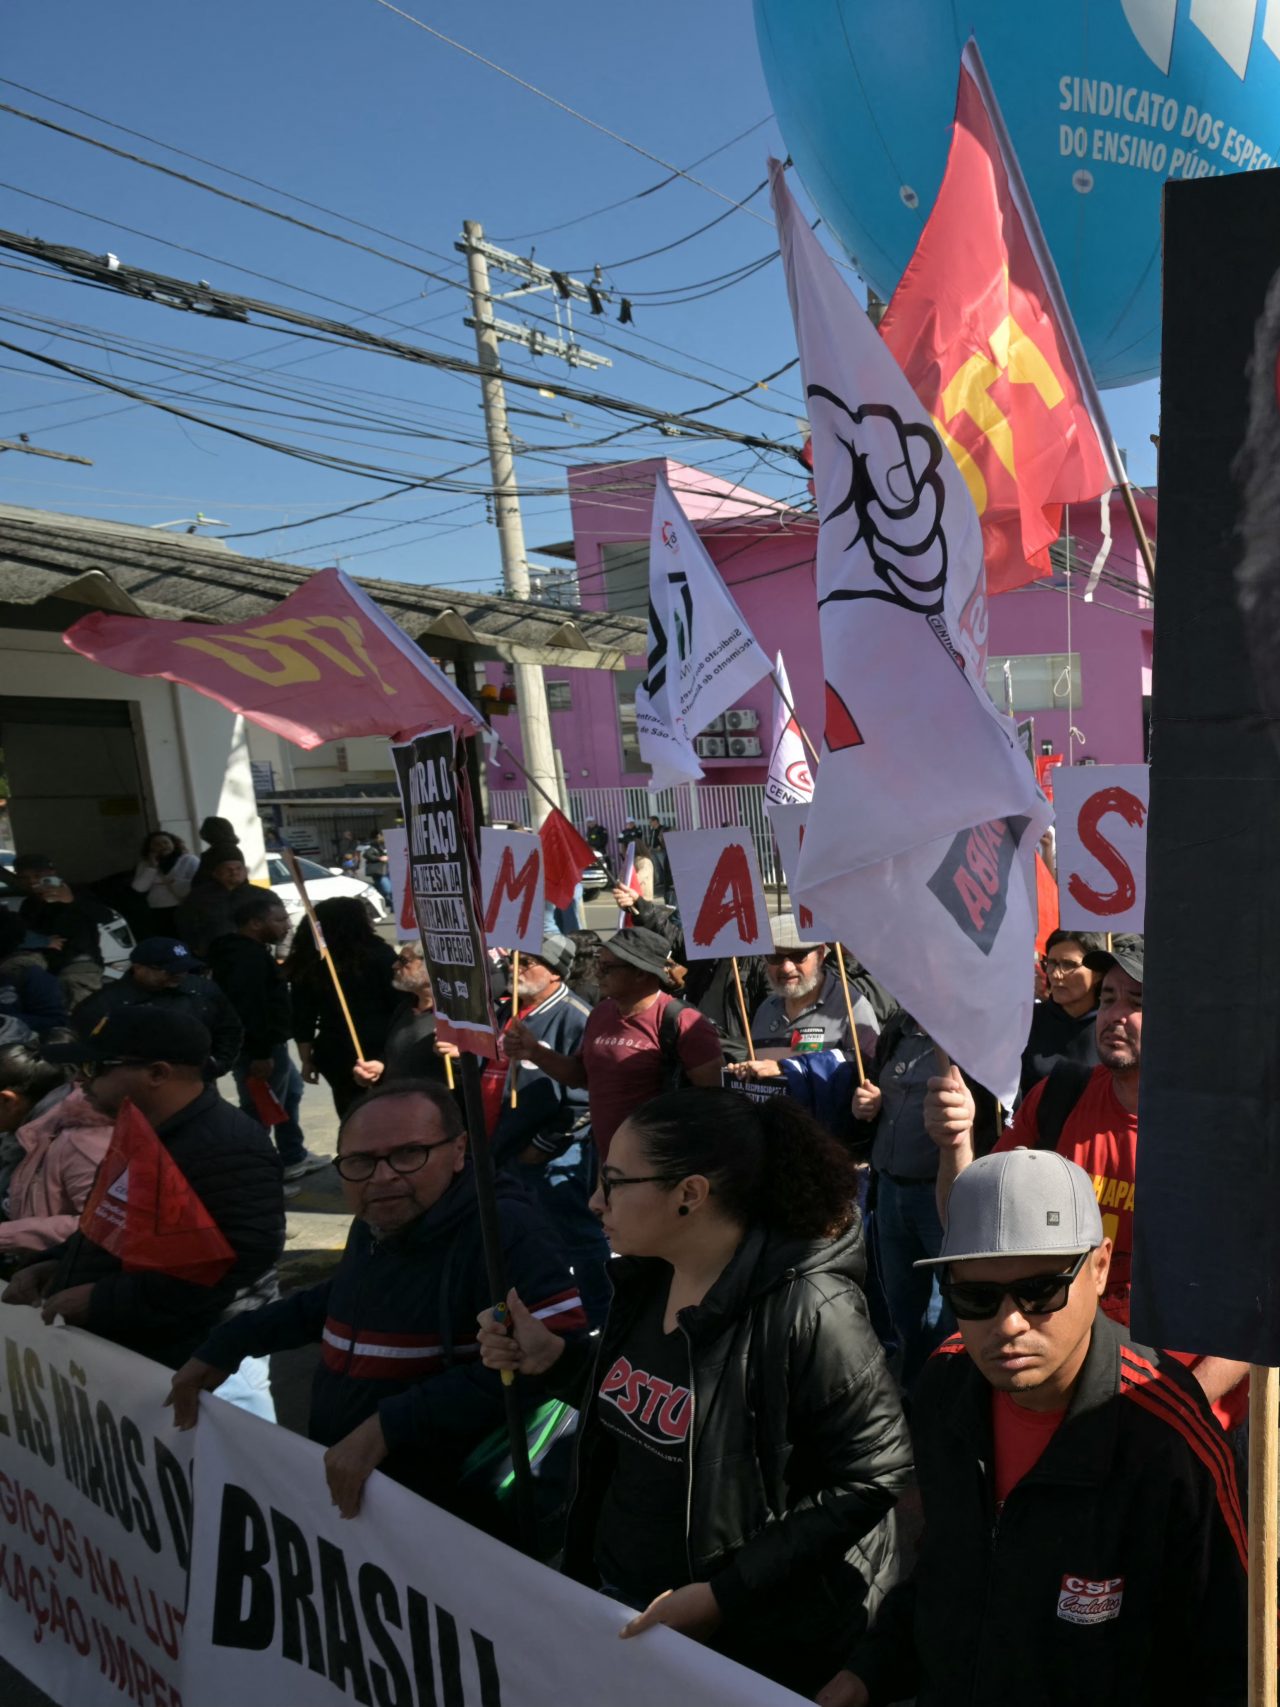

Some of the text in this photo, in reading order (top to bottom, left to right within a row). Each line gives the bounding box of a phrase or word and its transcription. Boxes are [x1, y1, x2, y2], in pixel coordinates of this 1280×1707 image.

[1059, 75, 1178, 132] SINDICATO
[1180, 105, 1225, 150] DOS
[1059, 124, 1087, 158] DO
[1092, 129, 1167, 173] ENSINO
[485, 845, 541, 940] M
[692, 843, 760, 946] A
[1068, 786, 1147, 916] S
[1091, 1174, 1136, 1212] HAPA
[599, 1355, 693, 1440] PSTU
[5, 1336, 194, 1572] AS MÃOS D
[83, 1535, 137, 1626] NA
[1066, 1577, 1121, 1595] CSP
